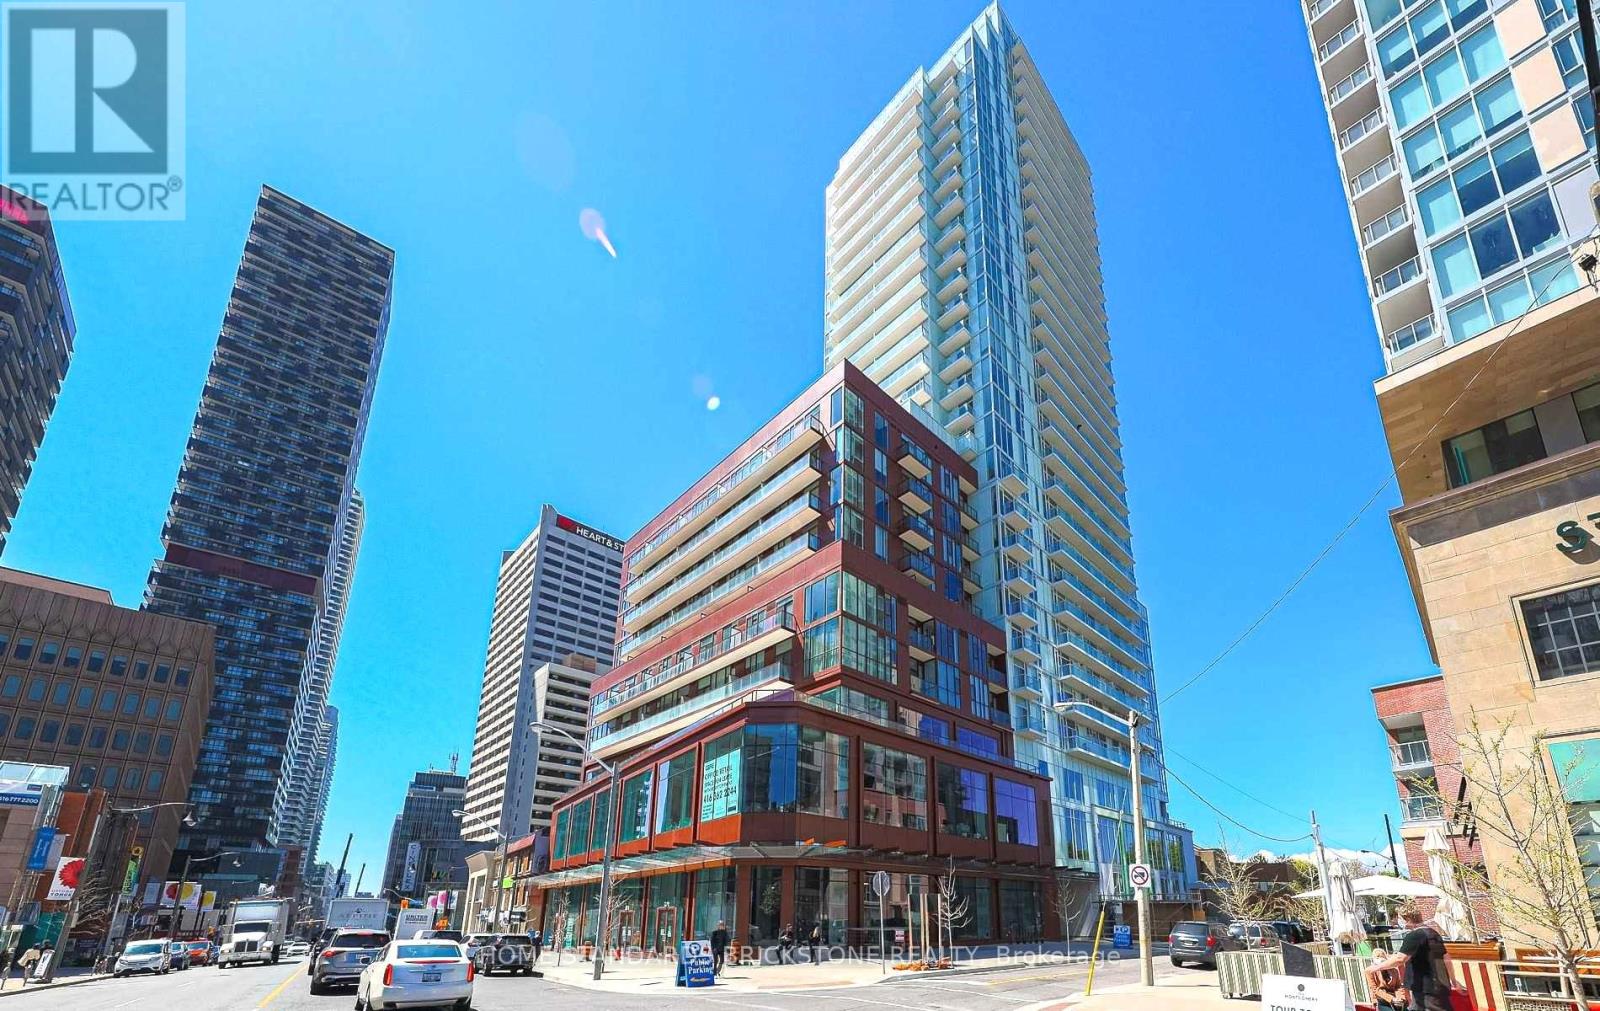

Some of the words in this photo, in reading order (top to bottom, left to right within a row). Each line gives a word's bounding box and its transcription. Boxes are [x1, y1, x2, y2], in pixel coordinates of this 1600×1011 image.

[576, 526, 606, 546] HEART
[606, 539, 613, 548] &
[689, 958, 711, 966] Public
